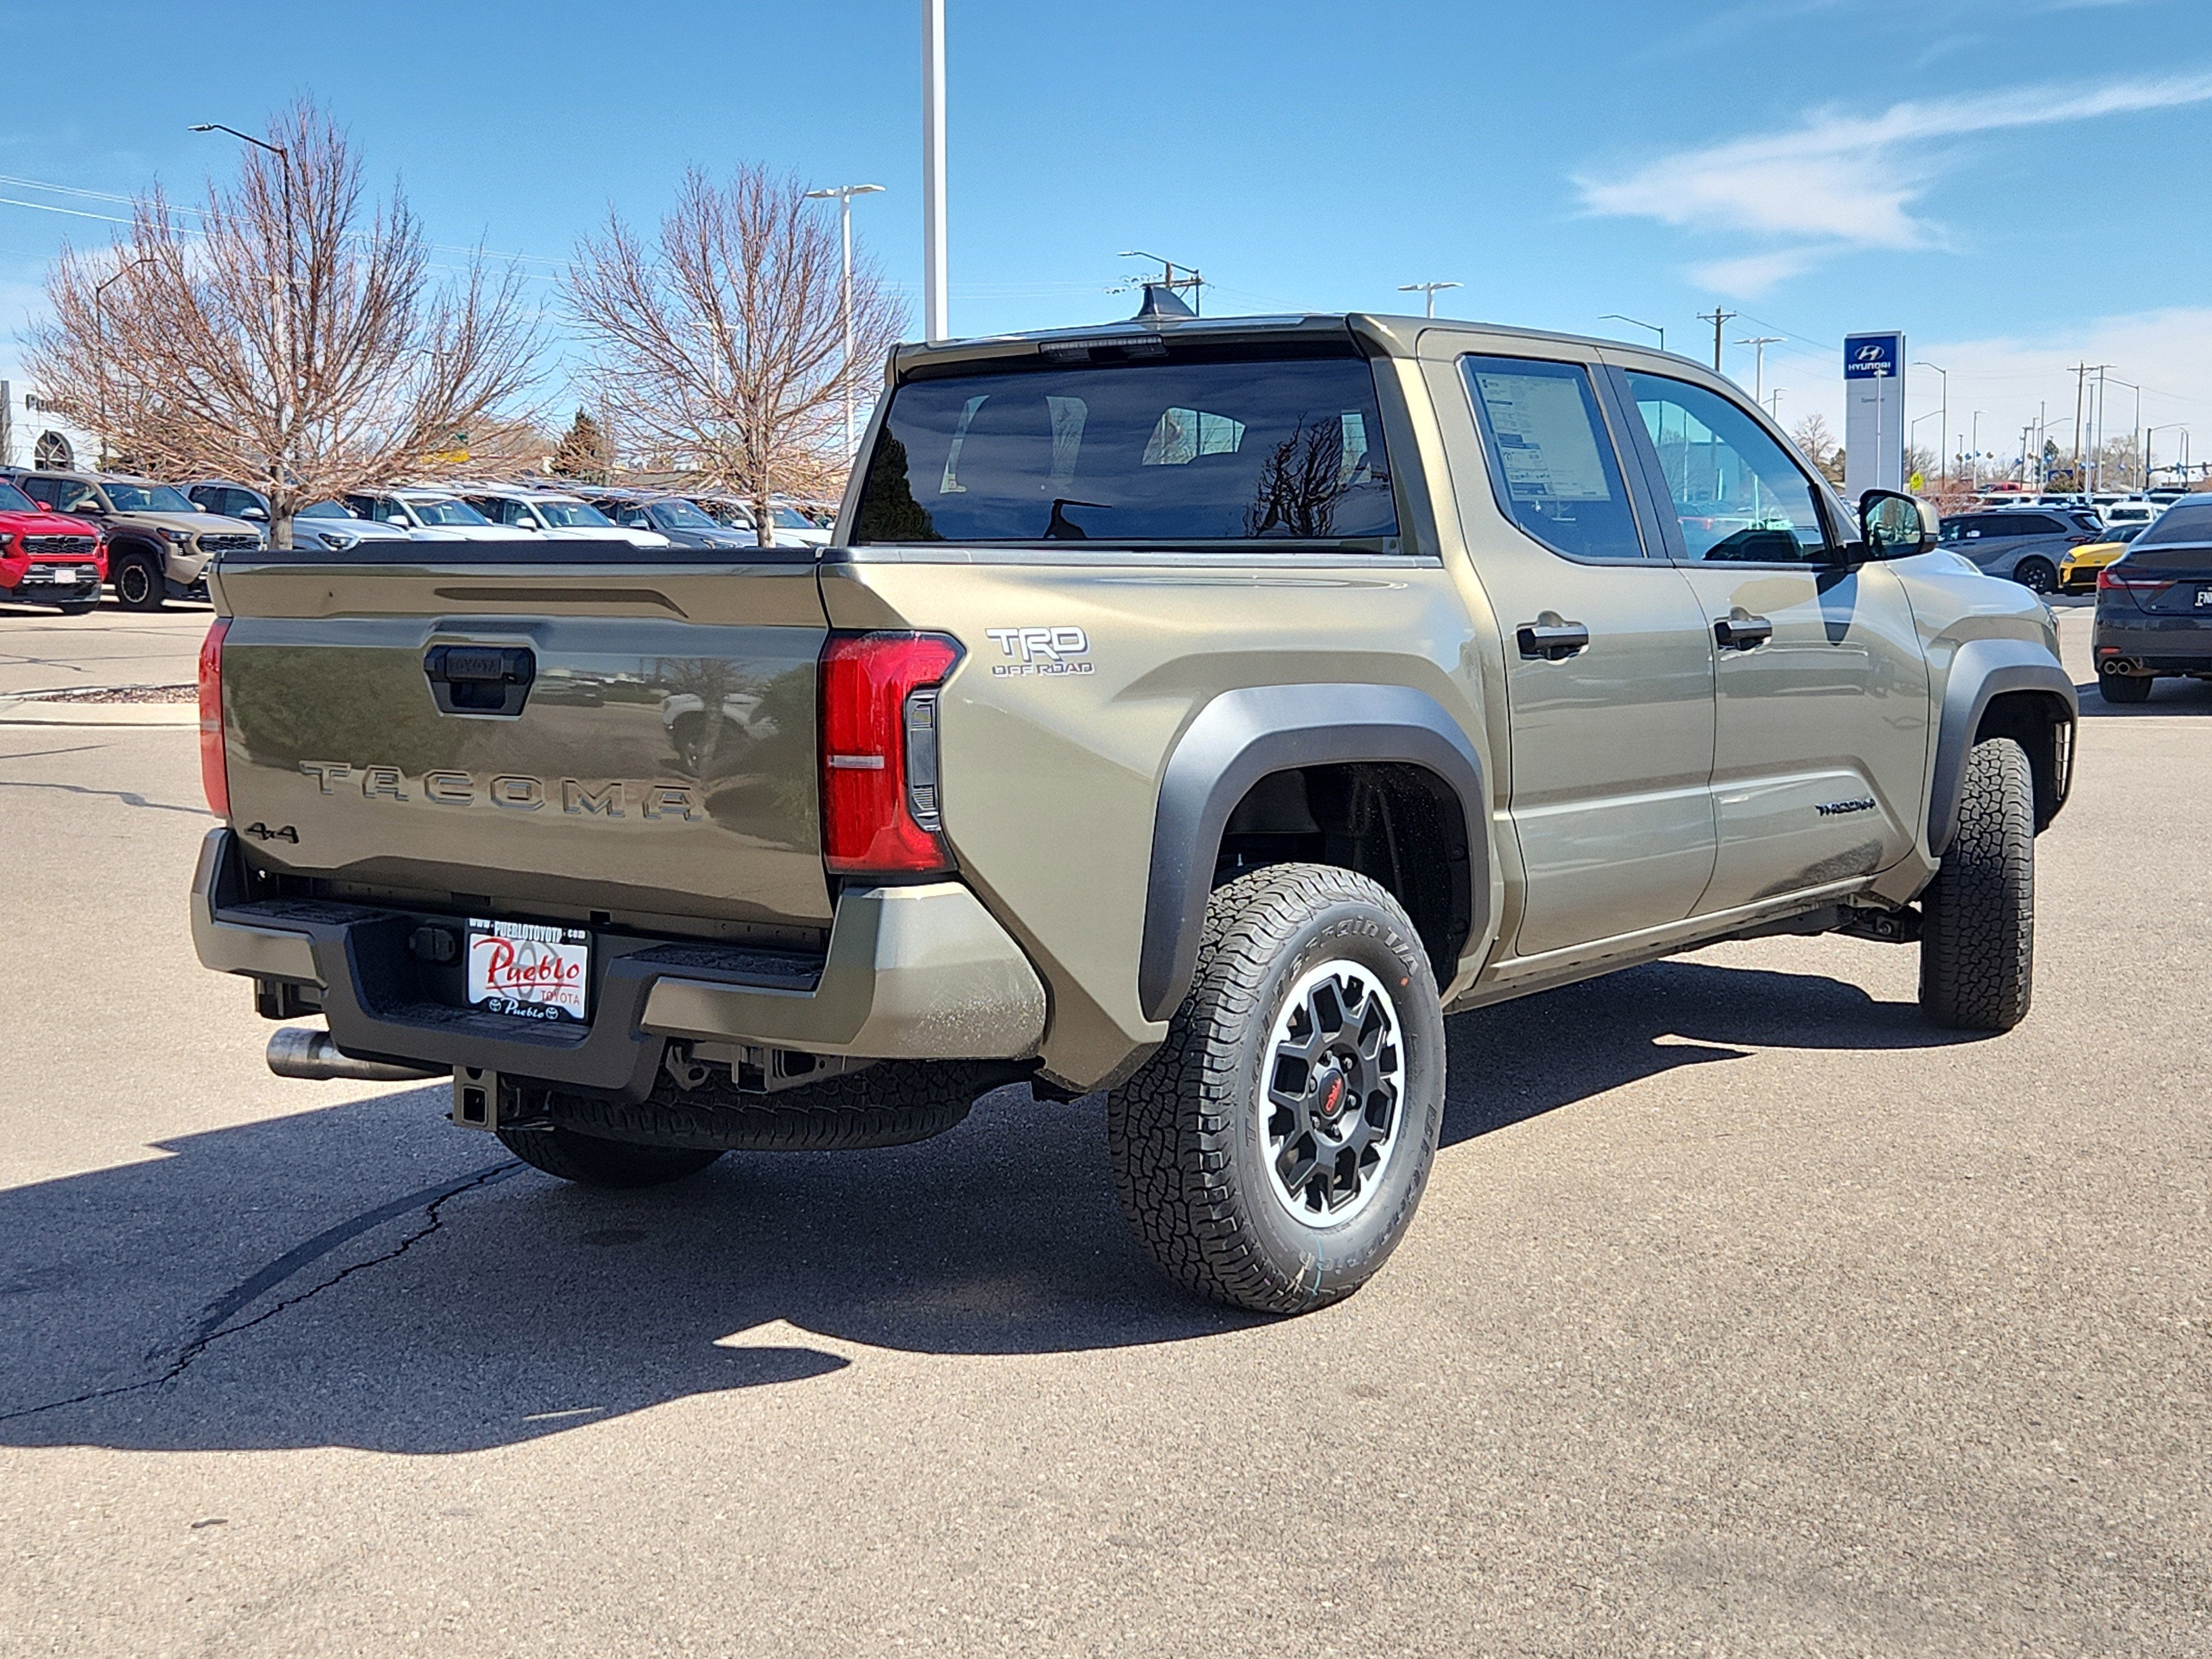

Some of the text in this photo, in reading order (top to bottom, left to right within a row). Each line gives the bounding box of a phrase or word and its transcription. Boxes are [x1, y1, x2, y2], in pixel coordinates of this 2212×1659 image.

[1848, 362, 1891, 371] HYUNDAI
[985, 626, 1091, 662] TRD
[1037, 661, 1095, 677] ROAD
[299, 760, 705, 821] TACOMA
[473, 937, 580, 984] Pueblo
[1384, 926, 1420, 978] T/A
[500, 996, 544, 1019] Pueblo
[541, 989, 580, 1005] TOYOTA
